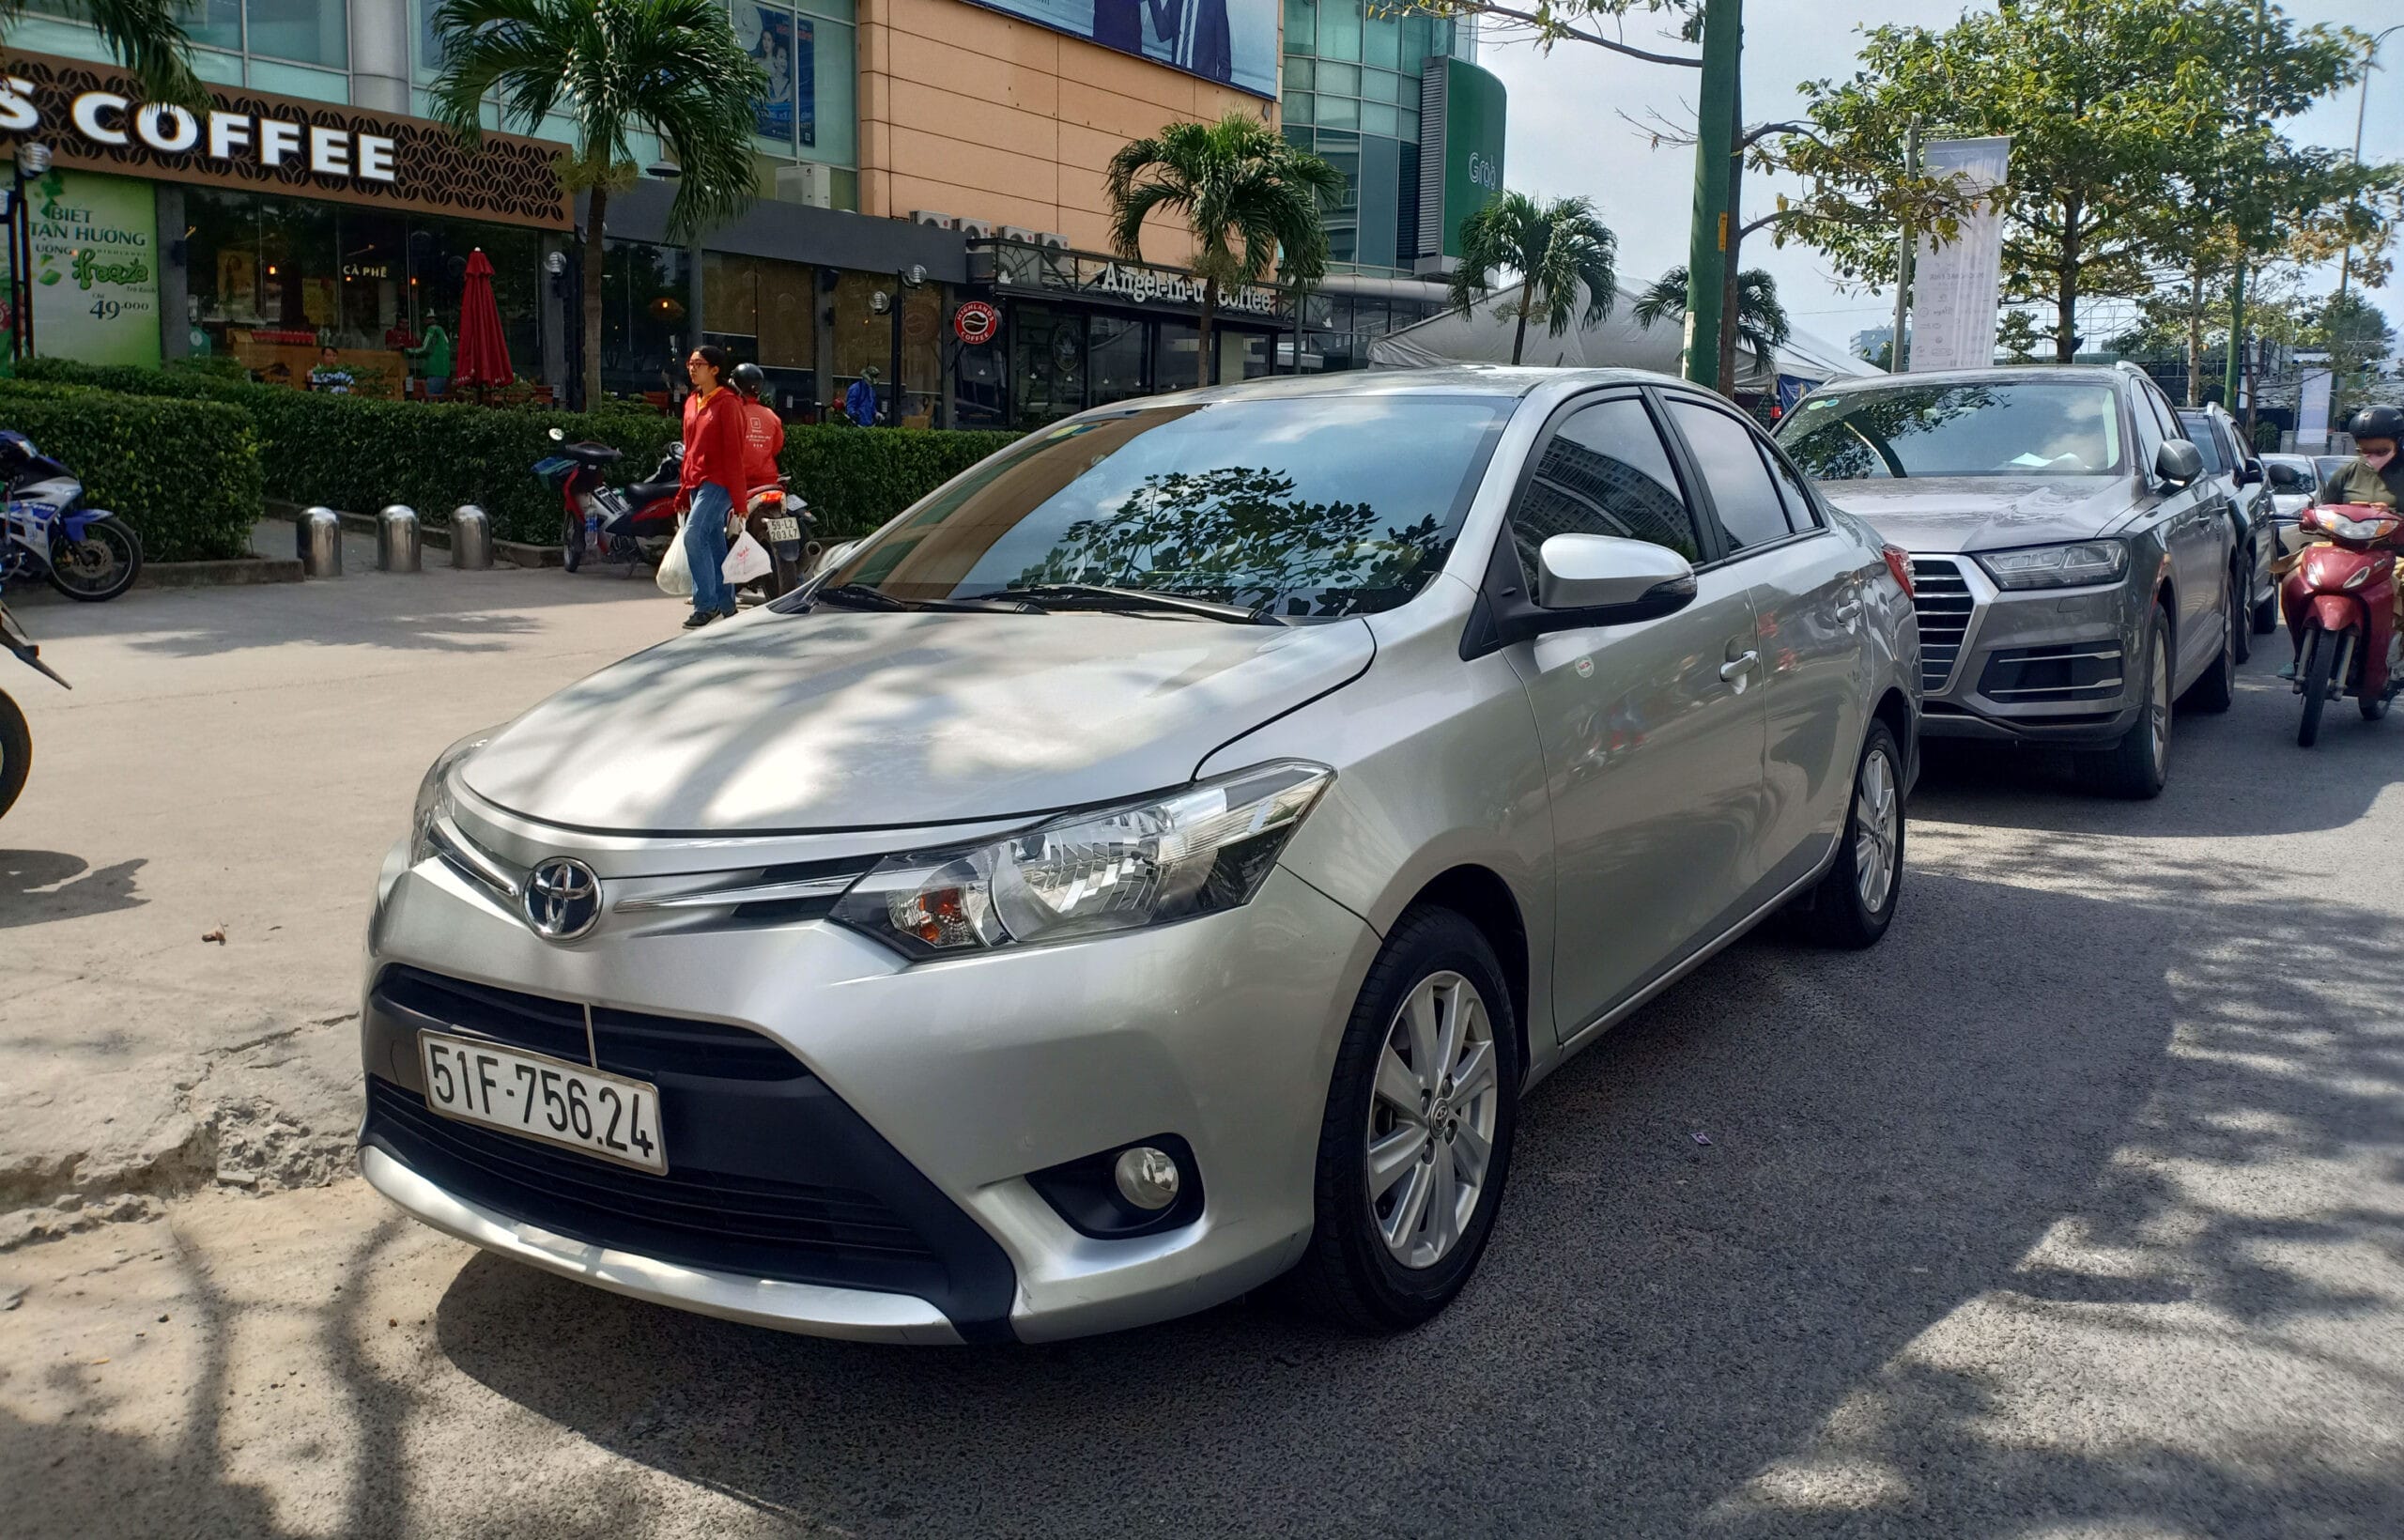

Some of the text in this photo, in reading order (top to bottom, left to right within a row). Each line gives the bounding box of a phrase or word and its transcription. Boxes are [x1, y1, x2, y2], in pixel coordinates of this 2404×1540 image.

[71, 91, 395, 182] COFFEE
[1469, 152, 1496, 190] Grab
[1102, 262, 1216, 307] Angel-in-u
[957, 304, 994, 321] HIGHLANDS
[961, 331, 990, 342] COFFEE
[429, 1043, 655, 1158] 51F-756.24
